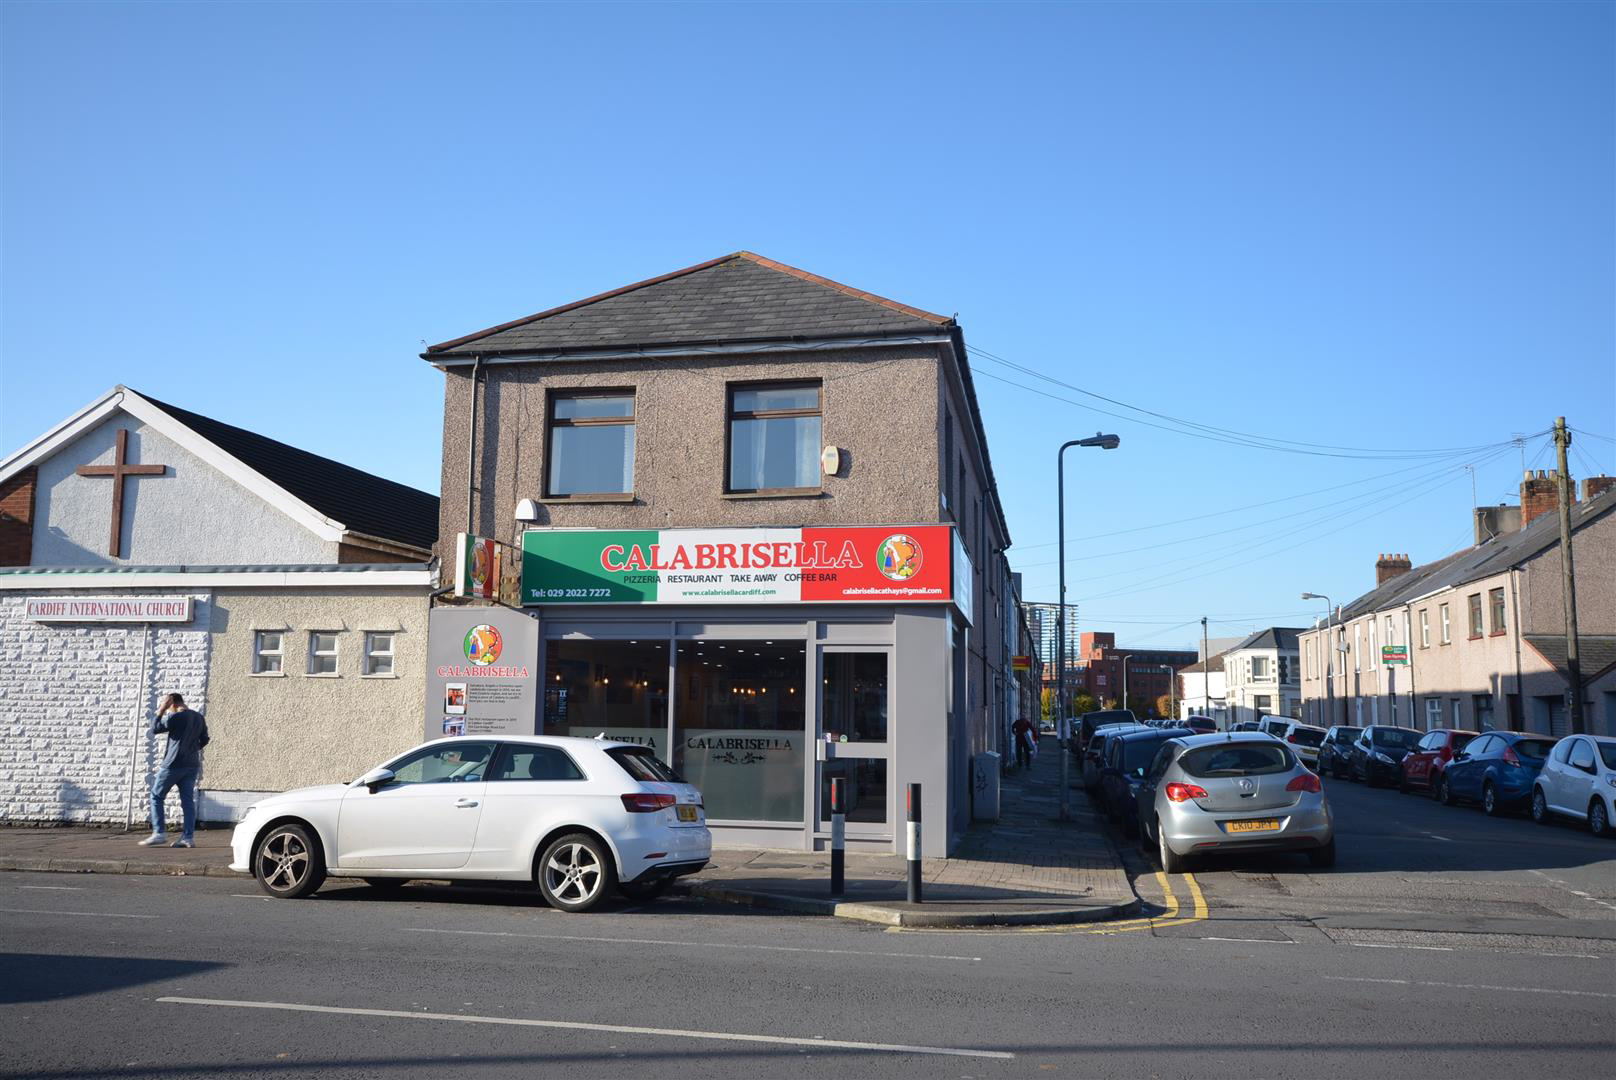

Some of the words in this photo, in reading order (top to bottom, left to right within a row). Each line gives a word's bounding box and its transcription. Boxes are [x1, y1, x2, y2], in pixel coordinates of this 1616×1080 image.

[600, 540, 864, 572] CALABRISELLA
[624, 575, 661, 584] PIZZERIA
[667, 574, 723, 583] RESTAURANT
[730, 574, 751, 583] TAKE
[753, 573, 778, 582] AWAY
[784, 573, 818, 582] COFFEE
[819, 573, 837, 582] BAR
[530, 588, 546, 598] Tel:
[547, 588, 564, 597] 029
[566, 588, 588, 597] 2022
[589, 588, 611, 597] 7272
[682, 588, 776, 596] www.calabrisellacardiff.com
[28, 602, 66, 616] CARDIFF
[69, 602, 143, 616] INTERNATIONAL
[146, 602, 185, 616] CHURCH
[437, 665, 529, 678] CALABRISELLA
[687, 738, 792, 750] CALABRISELLA
